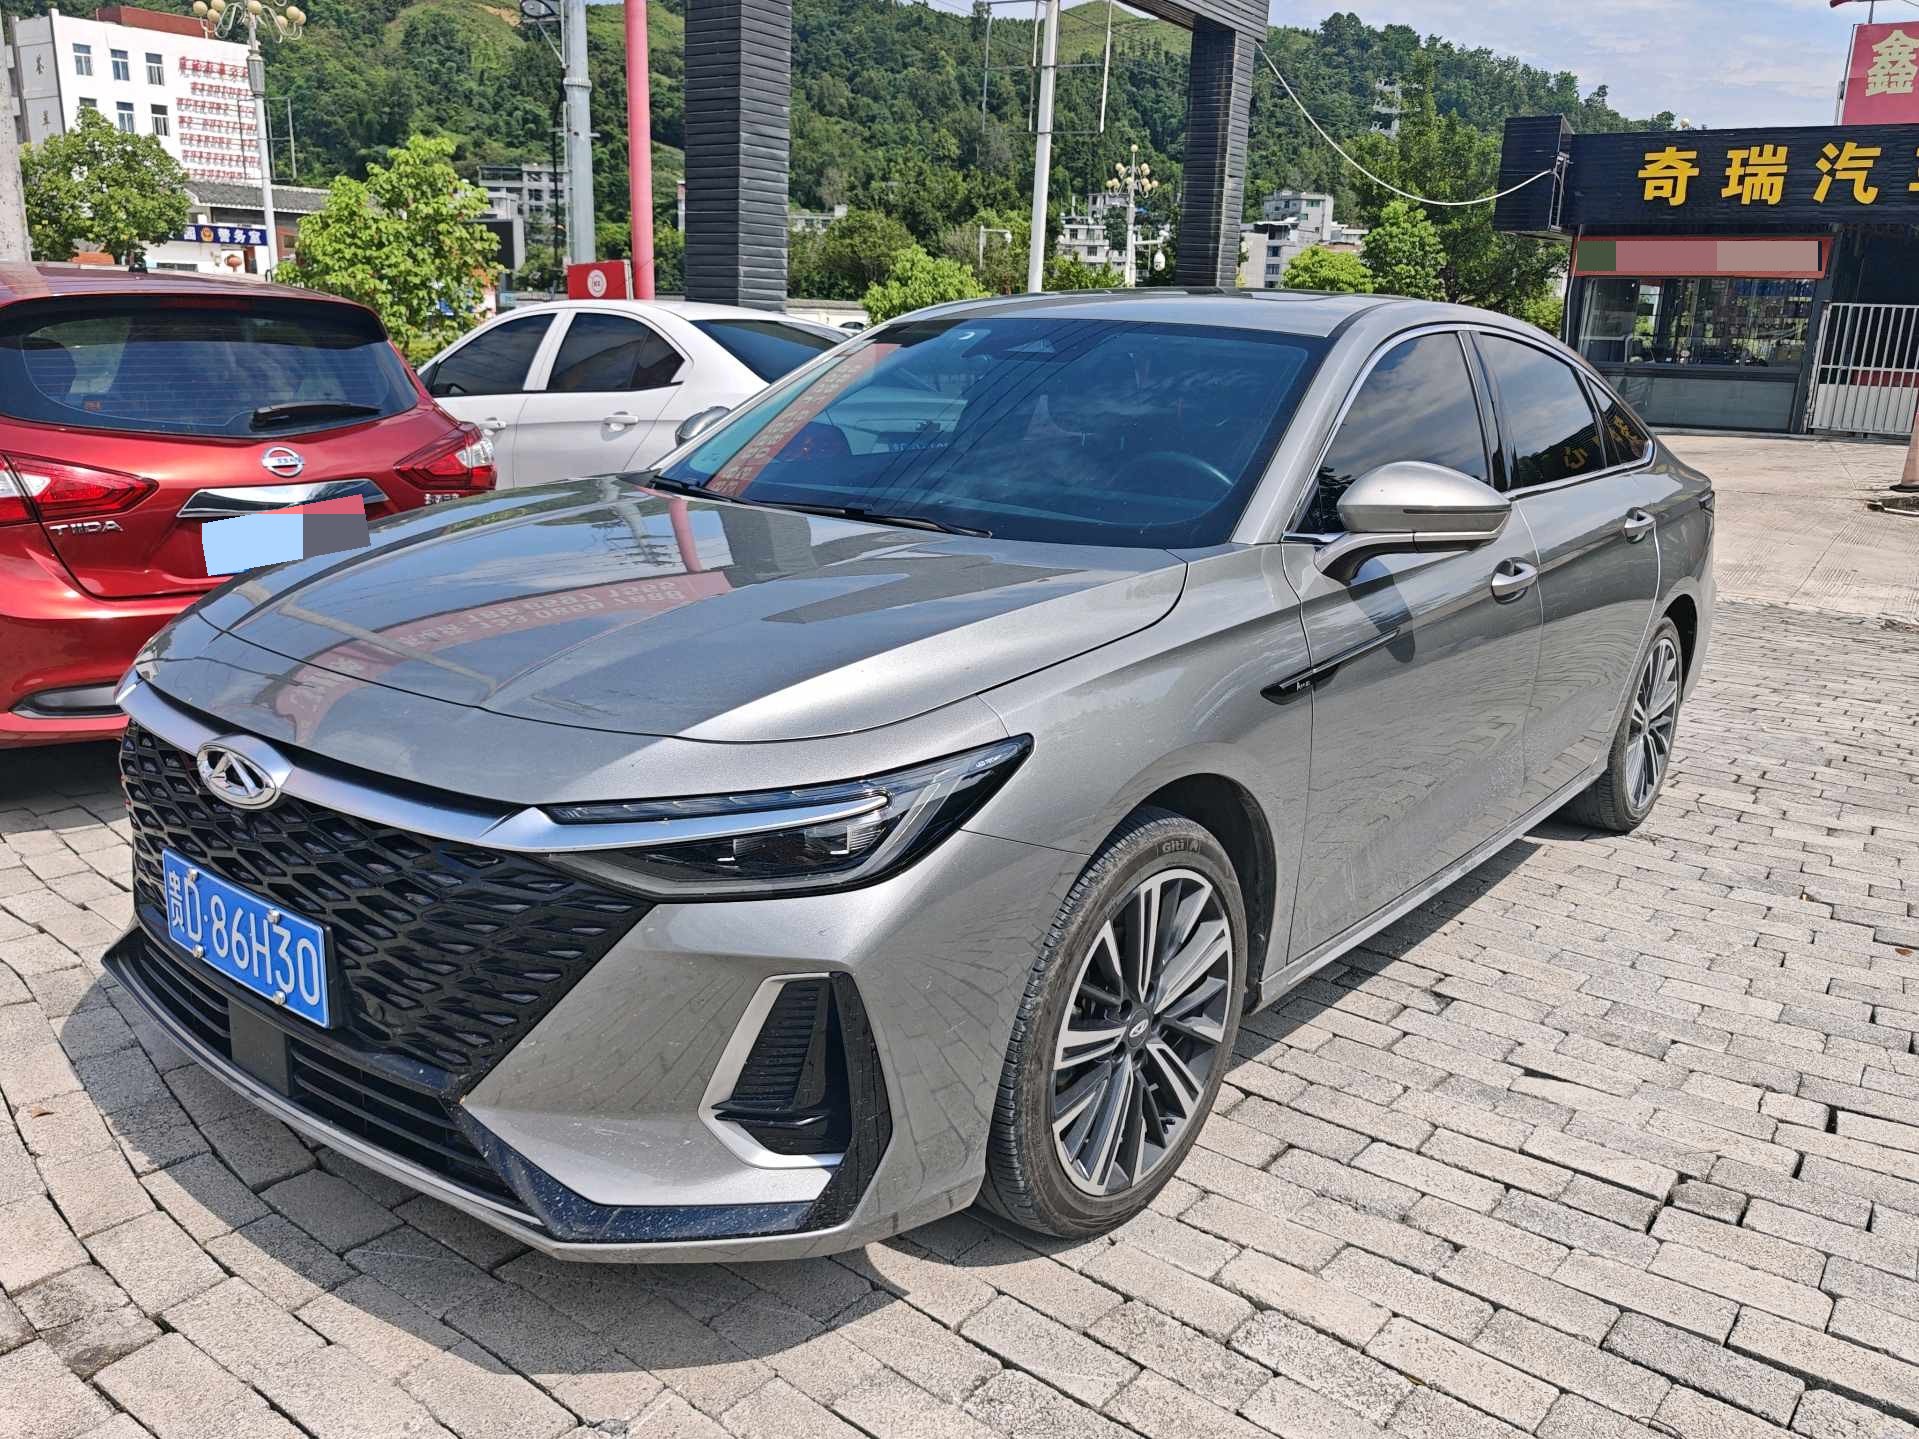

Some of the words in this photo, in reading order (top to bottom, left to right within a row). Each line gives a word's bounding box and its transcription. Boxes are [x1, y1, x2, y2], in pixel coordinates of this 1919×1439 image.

[1865, 29, 1919, 97] 鑫
[1638, 142, 1919, 206] 奇瑞汽
[49, 520, 124, 536] TIIDA
